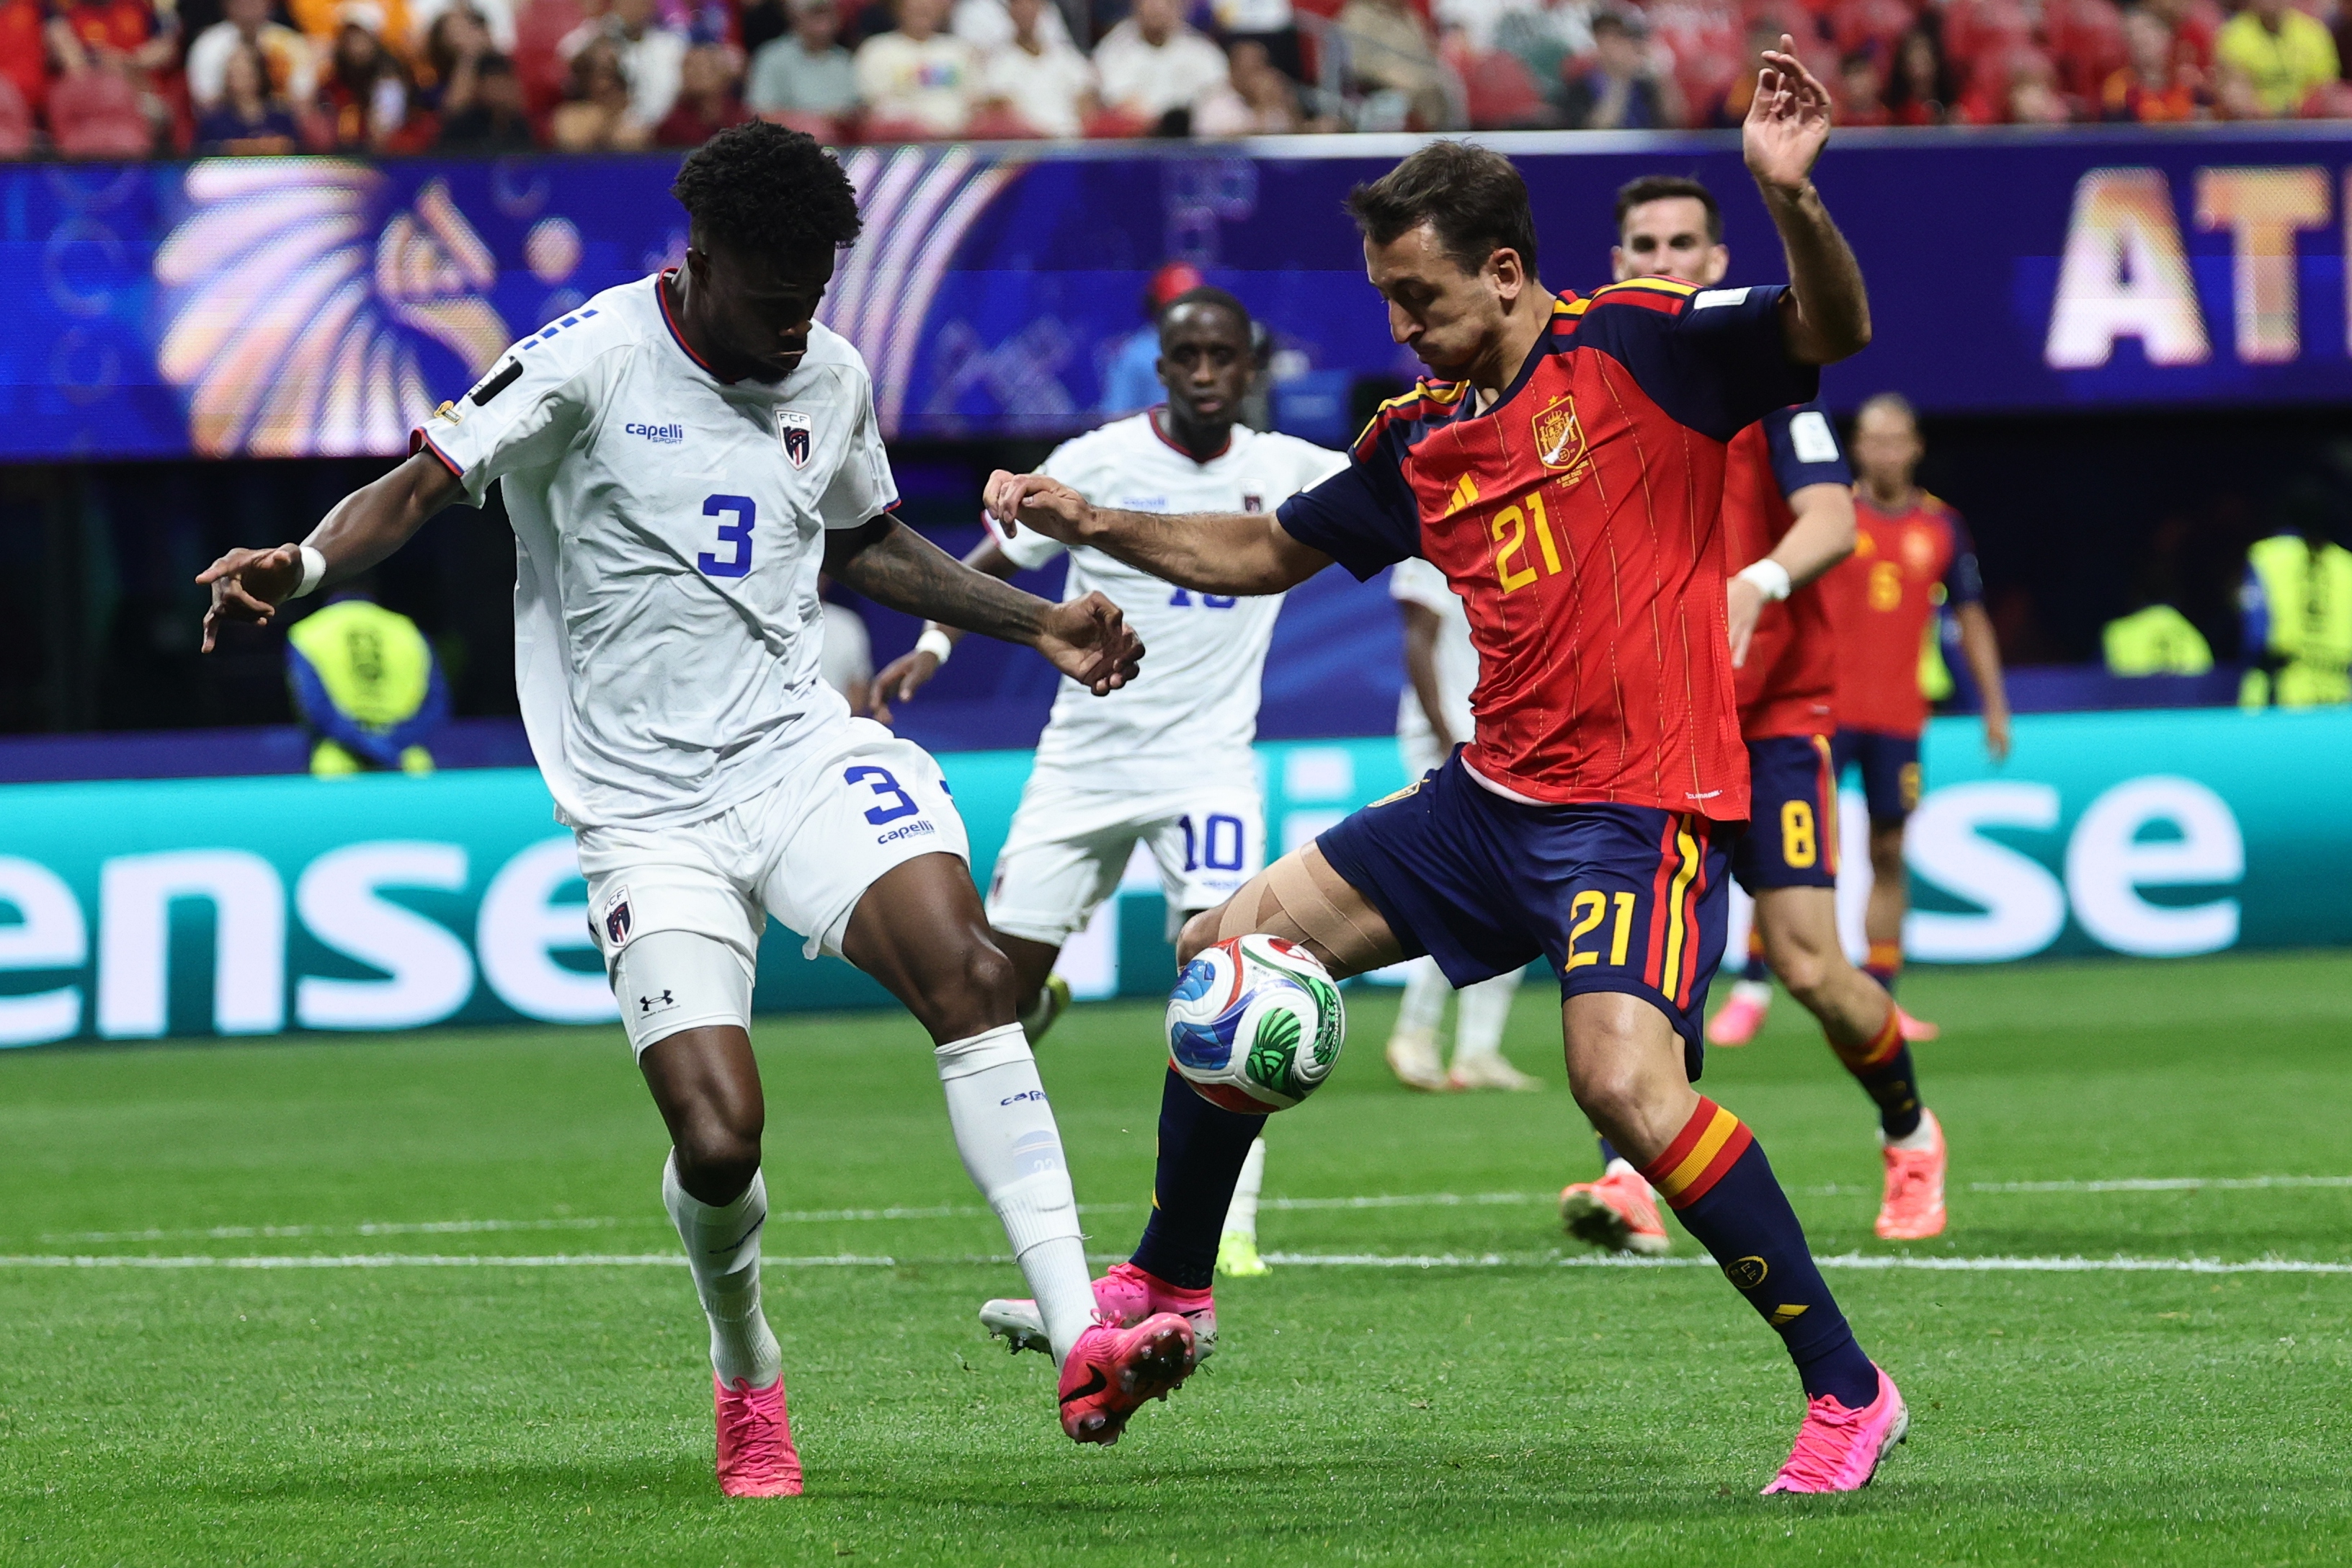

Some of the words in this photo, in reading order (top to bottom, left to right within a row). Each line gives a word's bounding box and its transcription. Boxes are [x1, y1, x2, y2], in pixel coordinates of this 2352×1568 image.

[2044, 165, 2352, 370] AT
[625, 424, 682, 440] capelli
[780, 413, 808, 423] FCF
[698, 494, 756, 578] 3
[1492, 491, 1562, 595] 21
[843, 765, 919, 825] 3
[877, 820, 935, 845] capelli
[1177, 814, 1242, 872] 10
[1781, 800, 1817, 869] 8
[1564, 890, 1636, 974] 21
